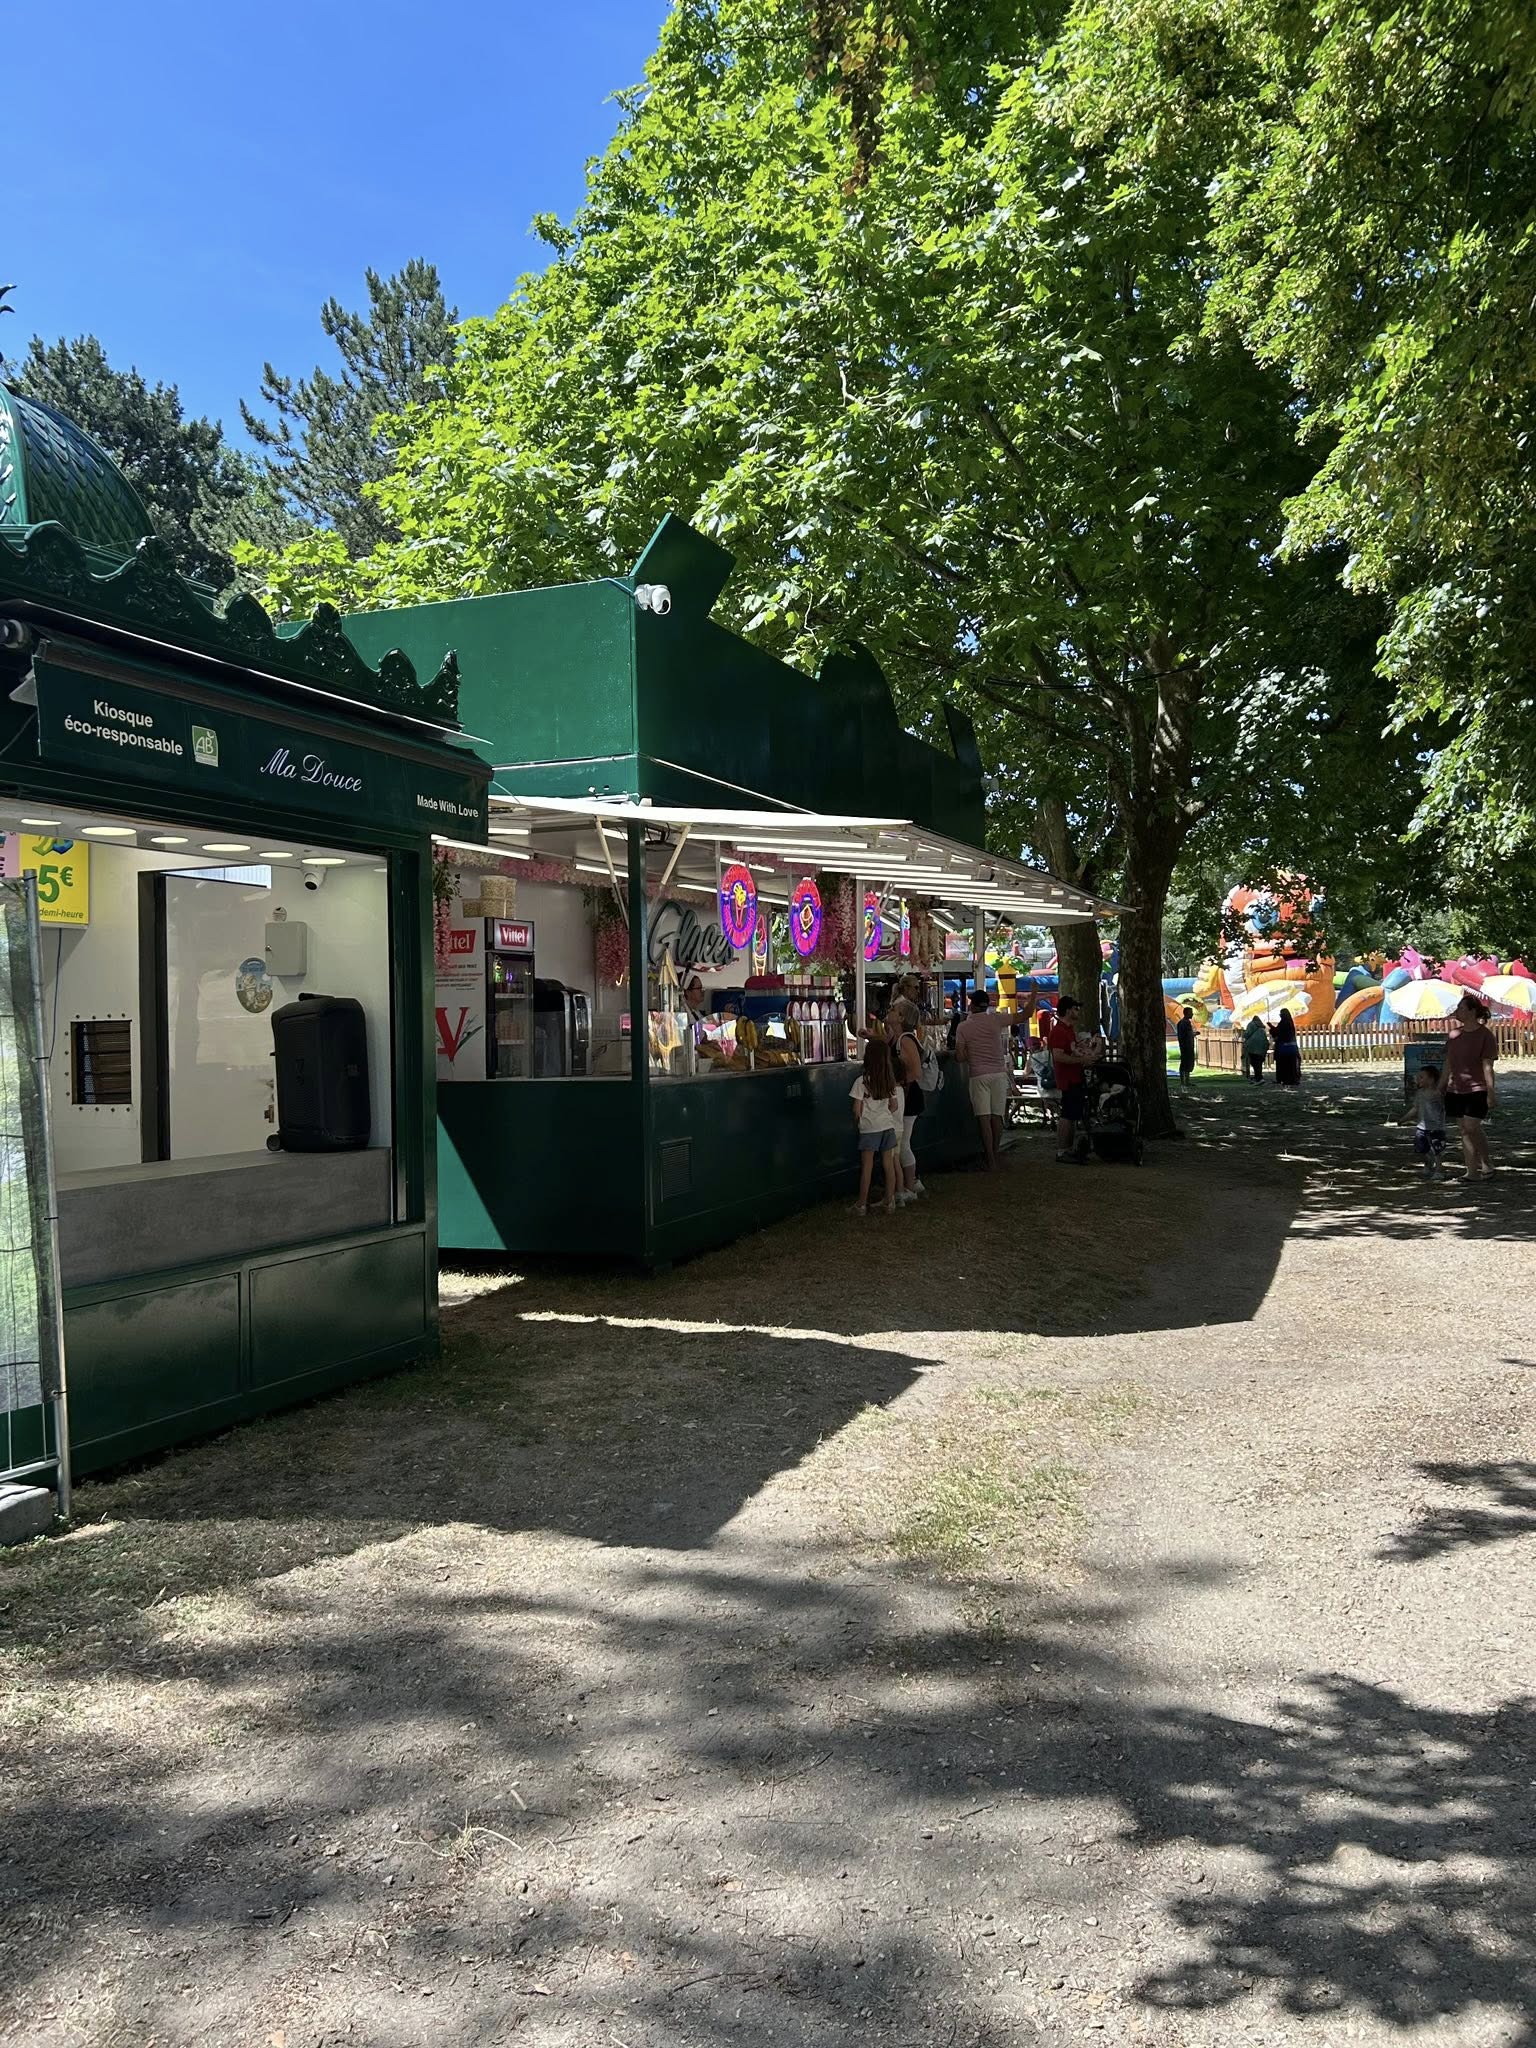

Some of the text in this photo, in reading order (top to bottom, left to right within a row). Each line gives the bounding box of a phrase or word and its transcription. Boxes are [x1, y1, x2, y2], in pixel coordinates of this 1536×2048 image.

[93, 699, 154, 728] Kiosque
[64, 714, 184, 756] éco-responsable
[195, 736, 215, 755] AB
[260, 748, 362, 792] Ma Douce
[416, 794, 479, 818] Made With Love
[38, 863, 74, 903] 5€
[39, 907, 84, 919] demi-heure
[501, 926, 526, 944] Vittel
